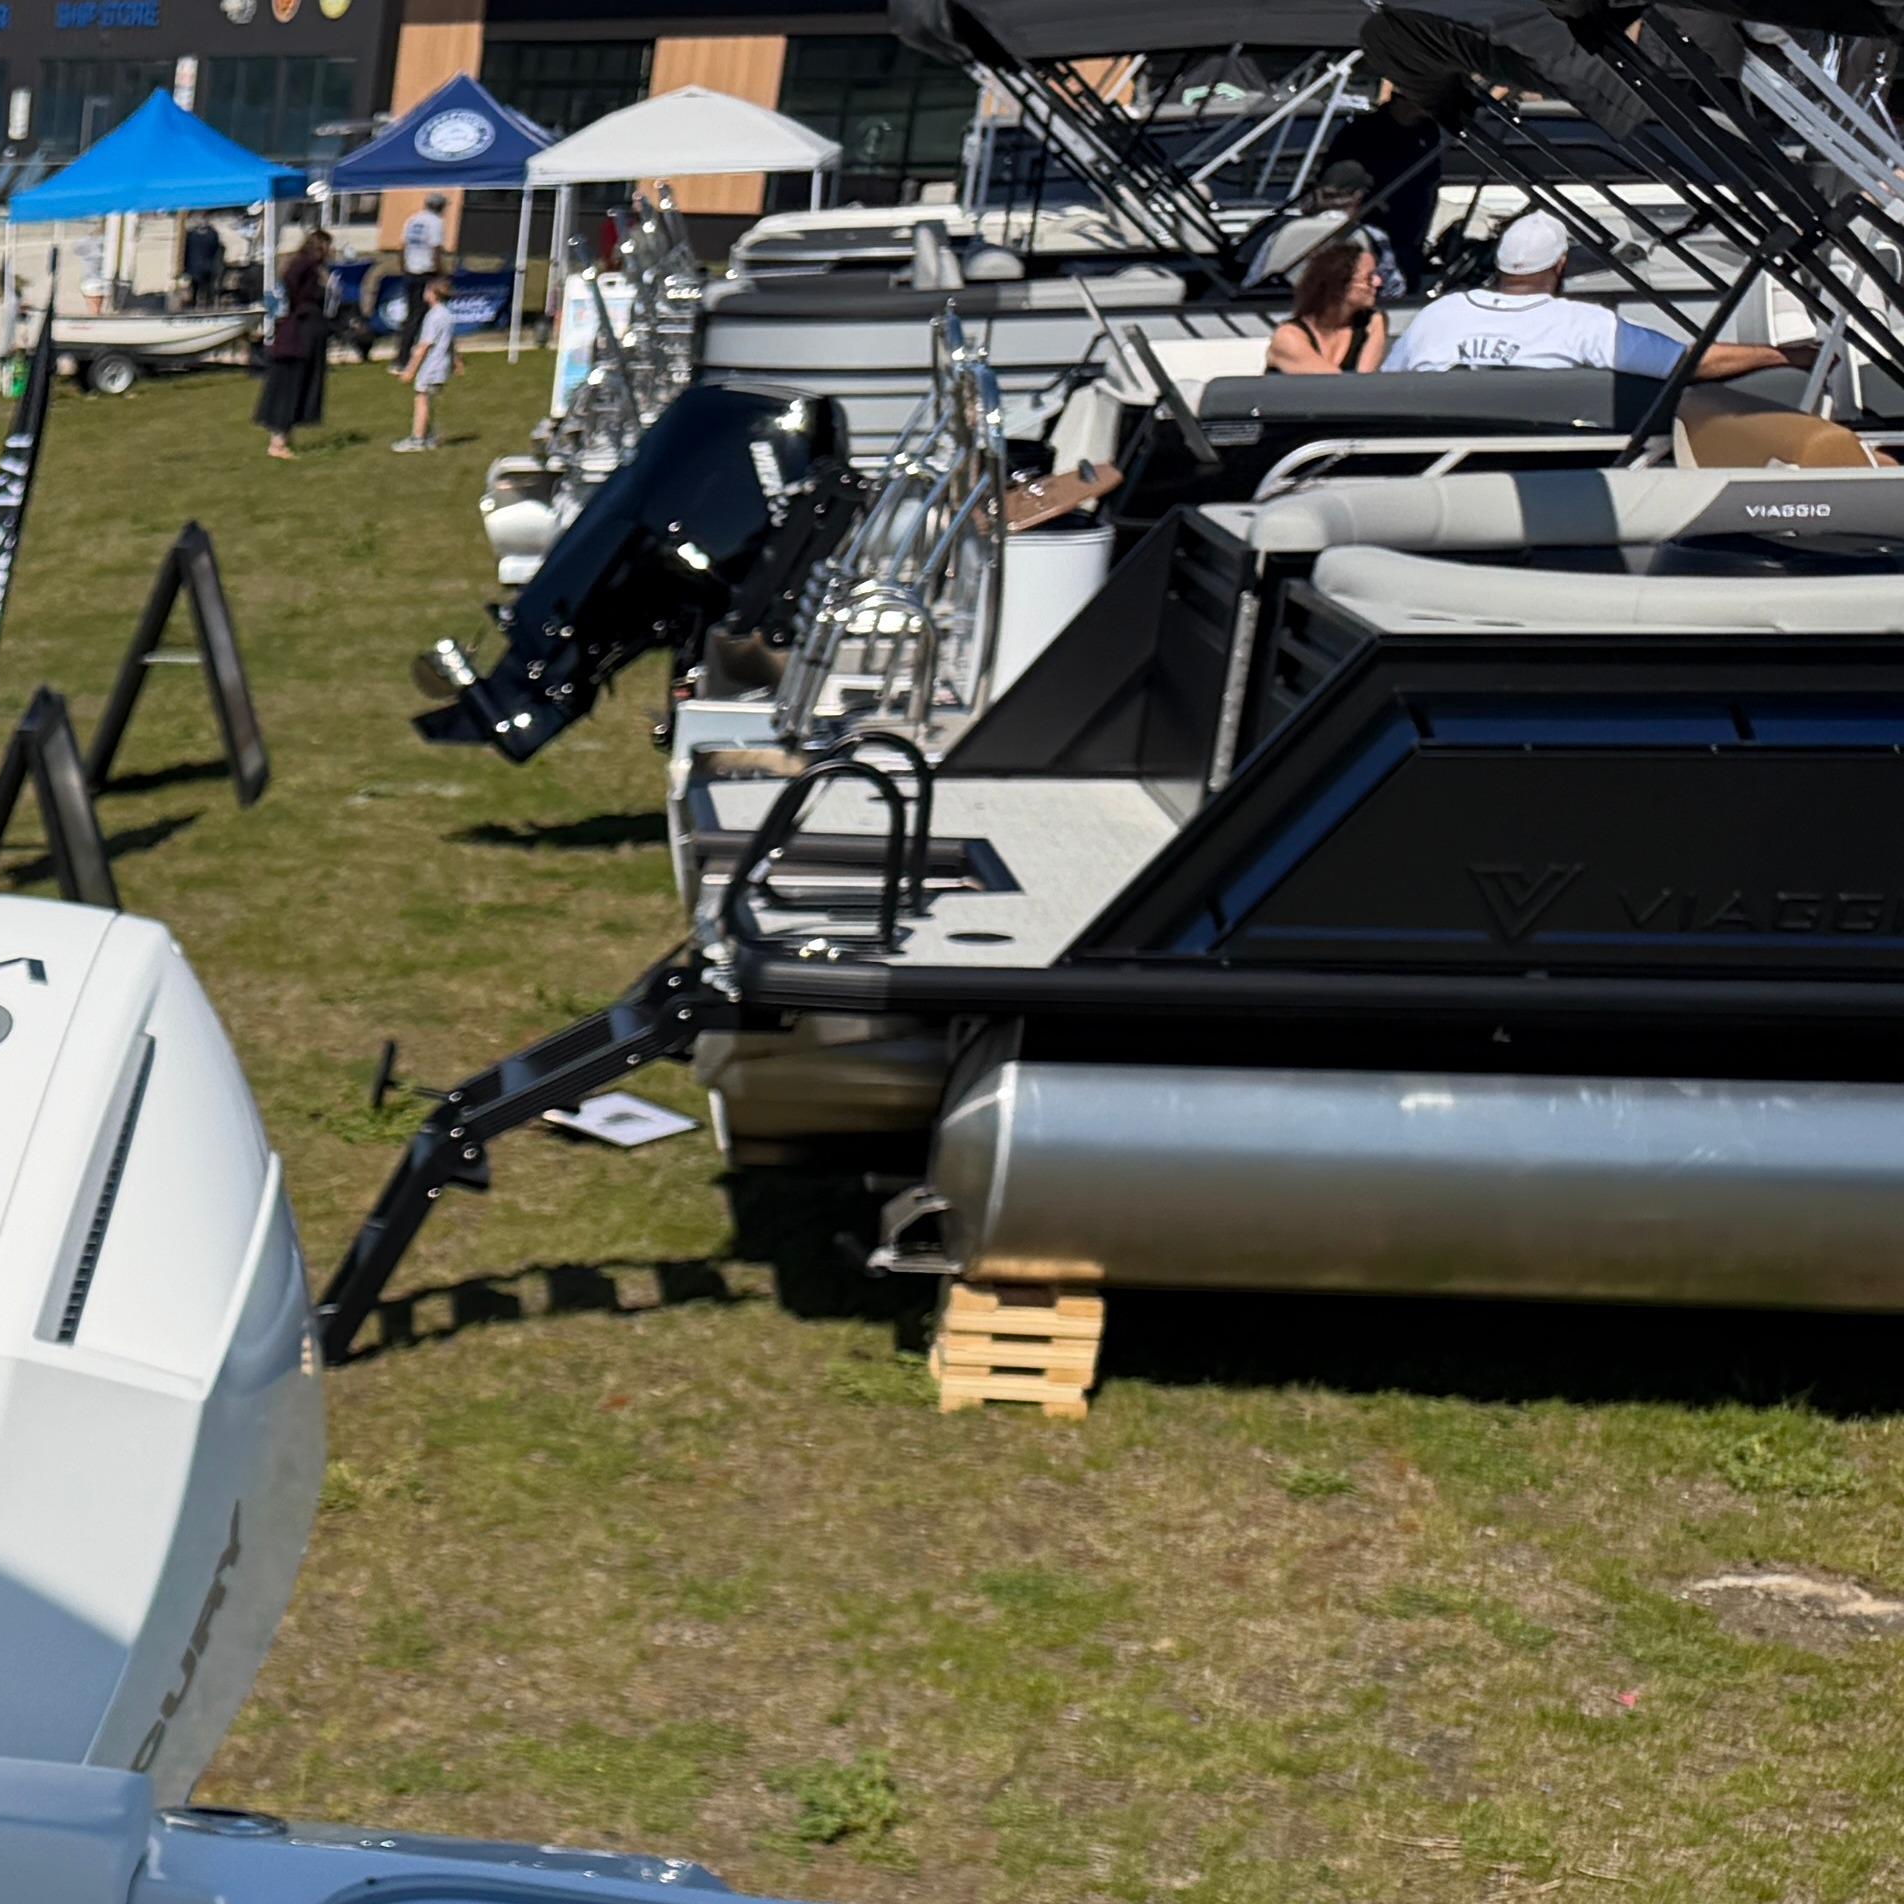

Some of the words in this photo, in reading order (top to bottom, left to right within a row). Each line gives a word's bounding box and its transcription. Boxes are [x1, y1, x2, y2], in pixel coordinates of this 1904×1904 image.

[1745, 504, 1831, 518] VIAGGIO
[1615, 887, 1904, 933] VIAGGI
[130, 1498, 241, 1772] CURY
